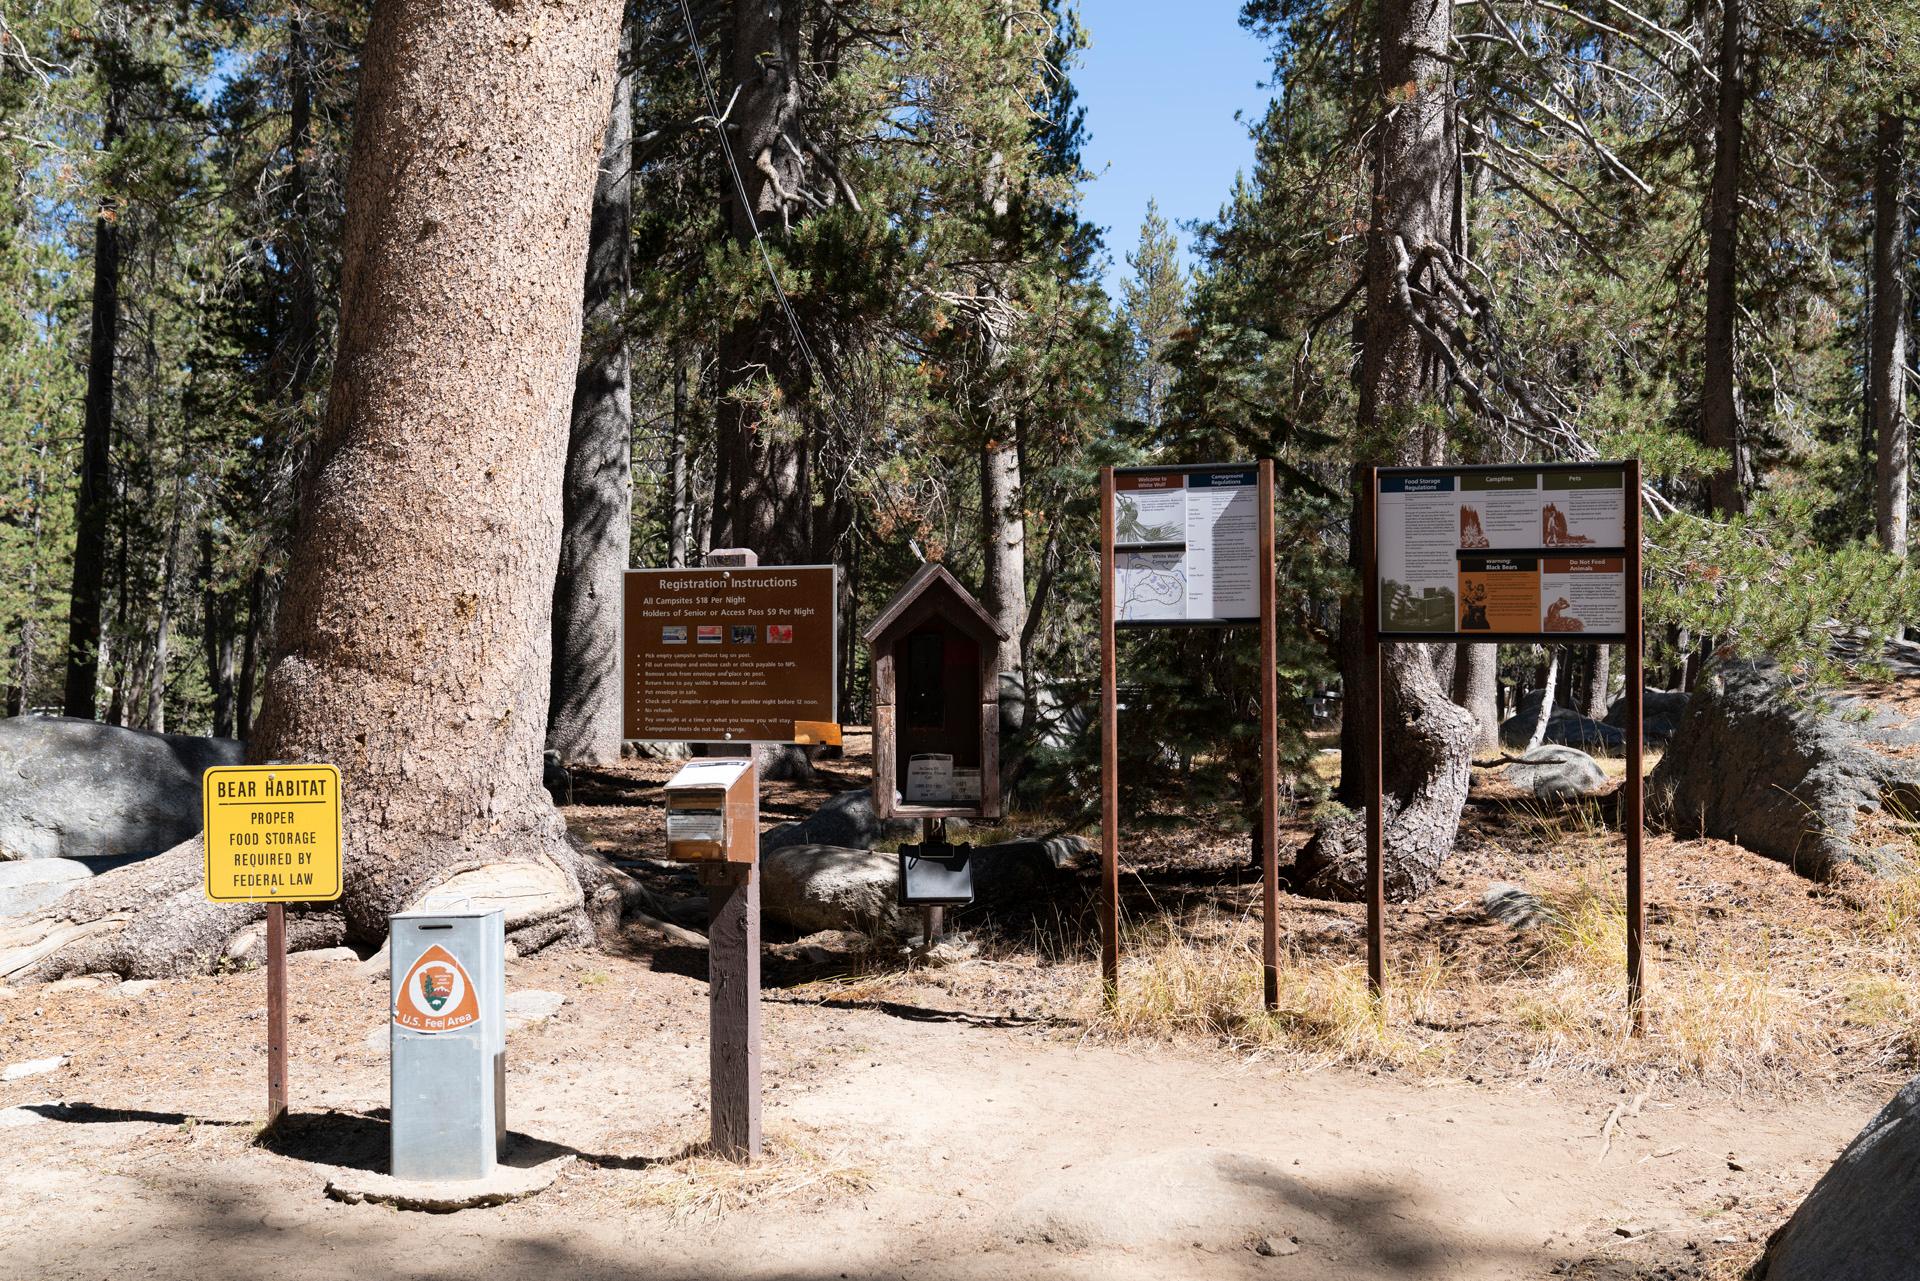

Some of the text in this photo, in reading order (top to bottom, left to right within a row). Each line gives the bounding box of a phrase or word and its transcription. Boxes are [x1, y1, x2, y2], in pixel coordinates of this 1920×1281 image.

[660, 577, 798, 592] Registration Instructions
[656, 597, 693, 606] Campsites
[726, 596, 746, 605] Night
[794, 608, 815, 617] Night
[218, 780, 326, 798] BEAR HABITAT
[251, 812, 294, 824] PROPER
[230, 832, 316, 846] FOOD STORAGE
[235, 853, 312, 866] REQUIRED BY
[234, 873, 313, 886] FEDERAL LAW
[402, 1014, 472, 1028] U.S. Fee Area
